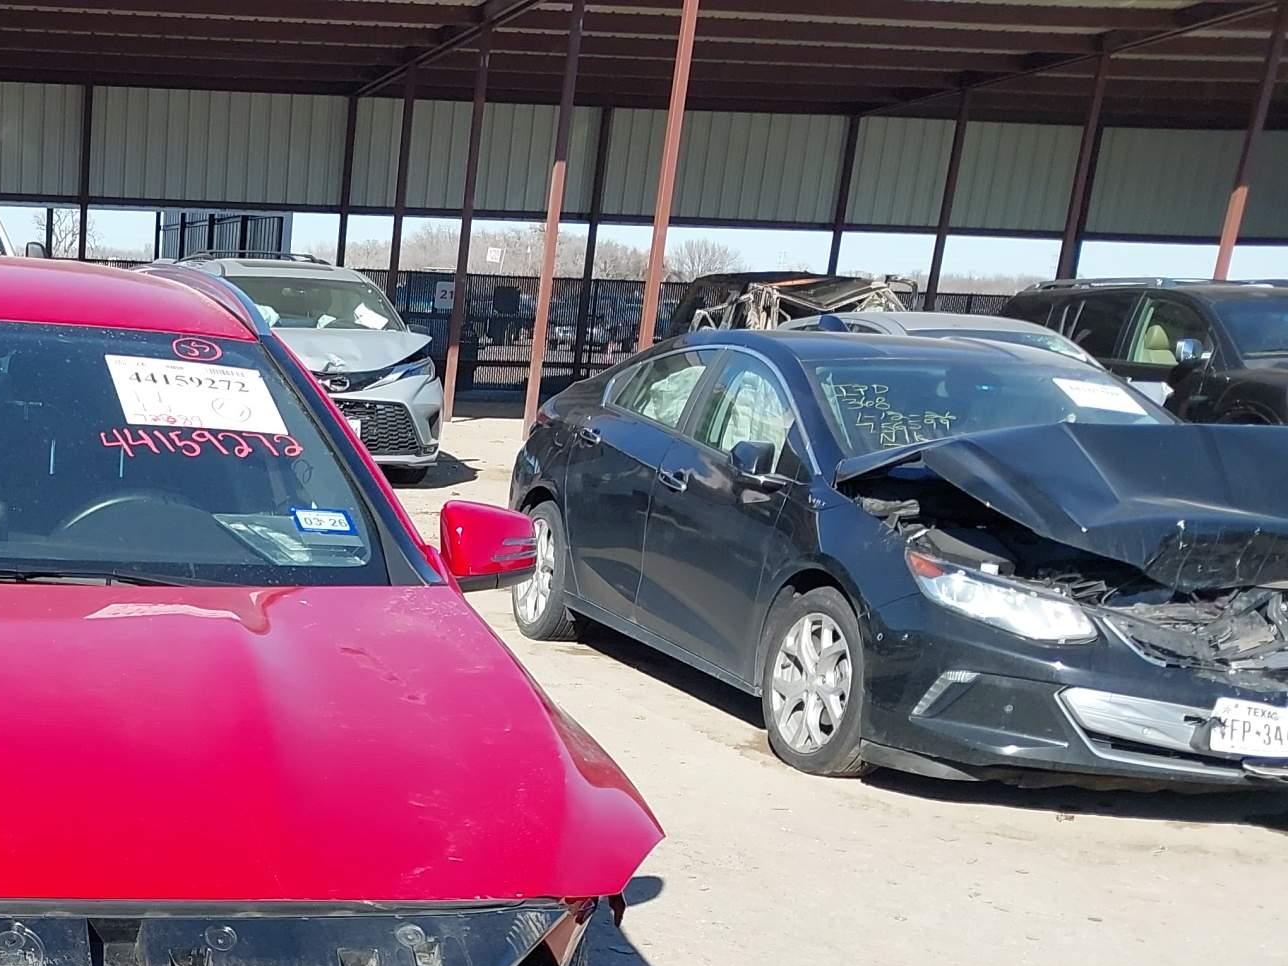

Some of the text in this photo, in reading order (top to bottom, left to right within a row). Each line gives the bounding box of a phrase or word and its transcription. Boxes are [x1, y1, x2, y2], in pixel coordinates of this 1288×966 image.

[128, 371, 250, 393] 44159272
[100, 429, 304, 458] 44159272
[328, 518, 348, 528] 26
